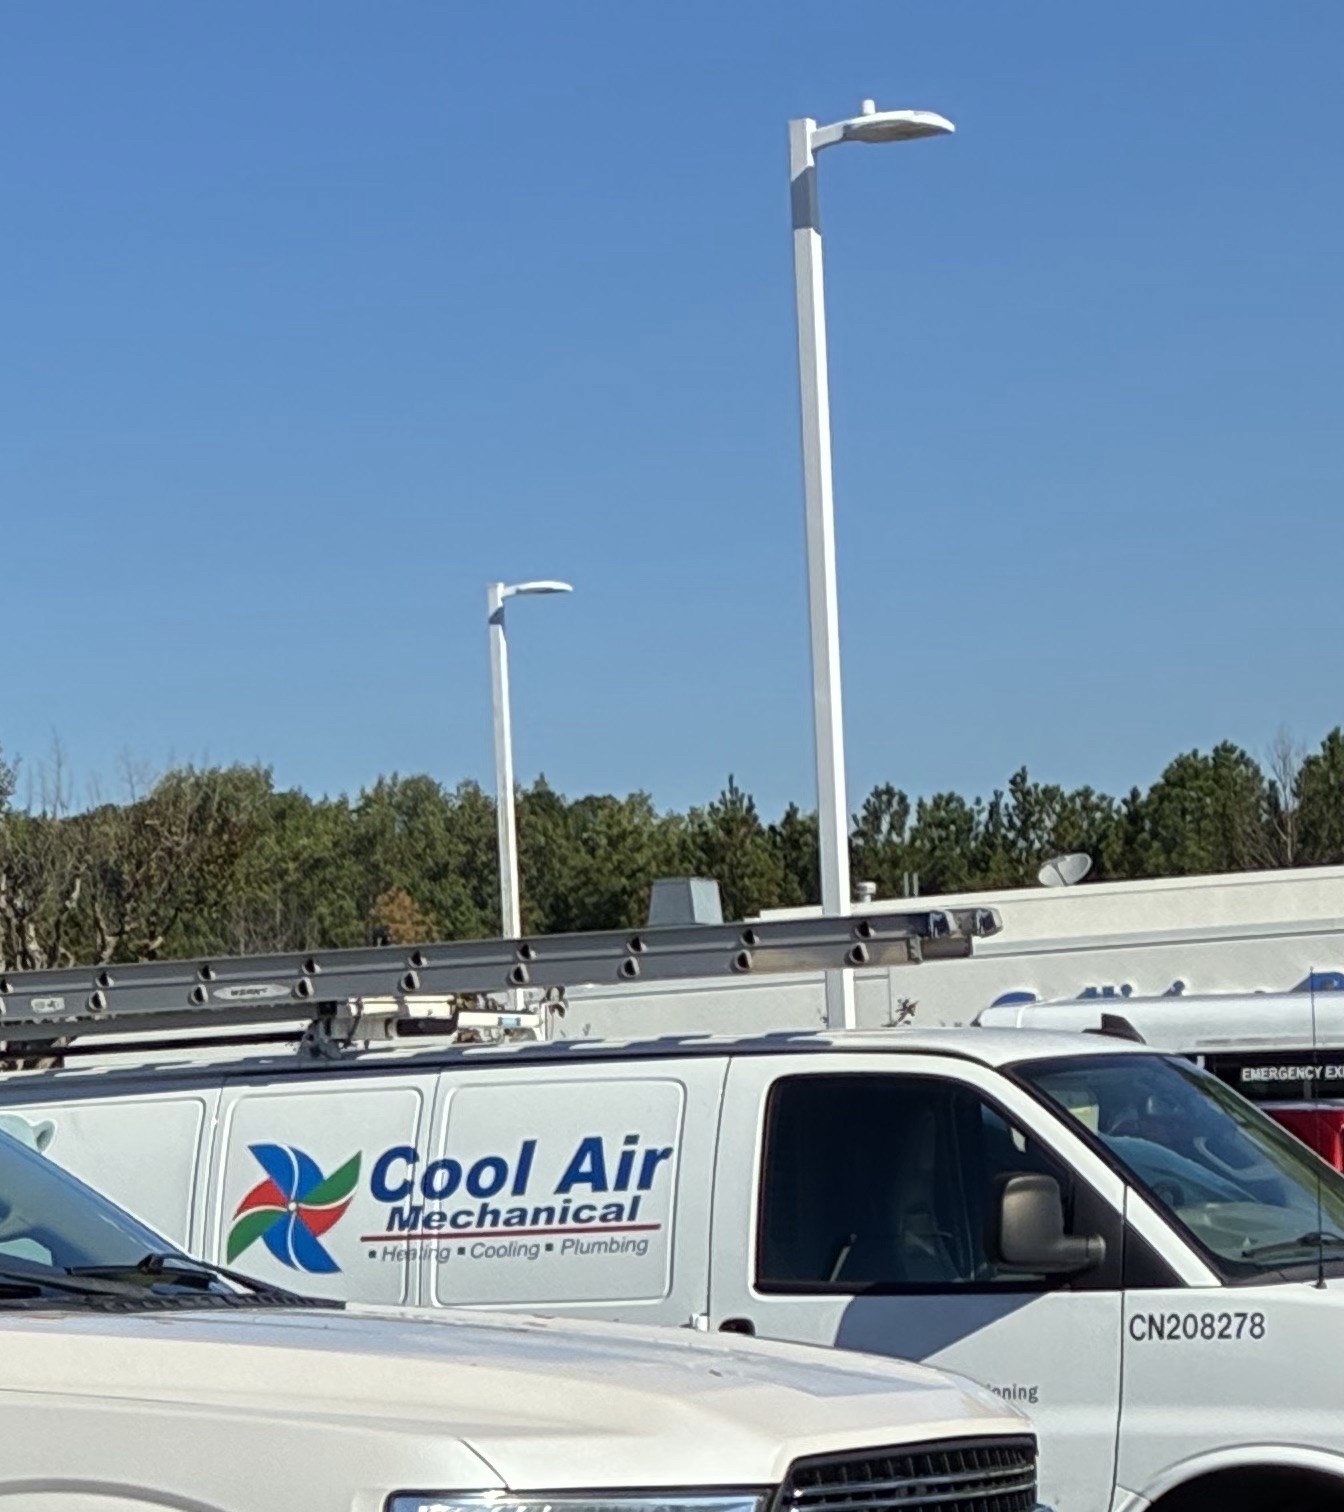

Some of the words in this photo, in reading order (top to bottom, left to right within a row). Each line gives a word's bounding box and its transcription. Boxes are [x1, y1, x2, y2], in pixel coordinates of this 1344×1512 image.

[1242, 1065, 1322, 1081] EMERGENCY
[370, 1139, 537, 1203] Cool
[553, 1134, 673, 1195] Air
[385, 1195, 641, 1232] Mechanical
[381, 1245, 451, 1264] Heating
[470, 1240, 540, 1261] Cooling
[561, 1236, 649, 1256] Plumbing
[1129, 1312, 1266, 1341] CN208278
